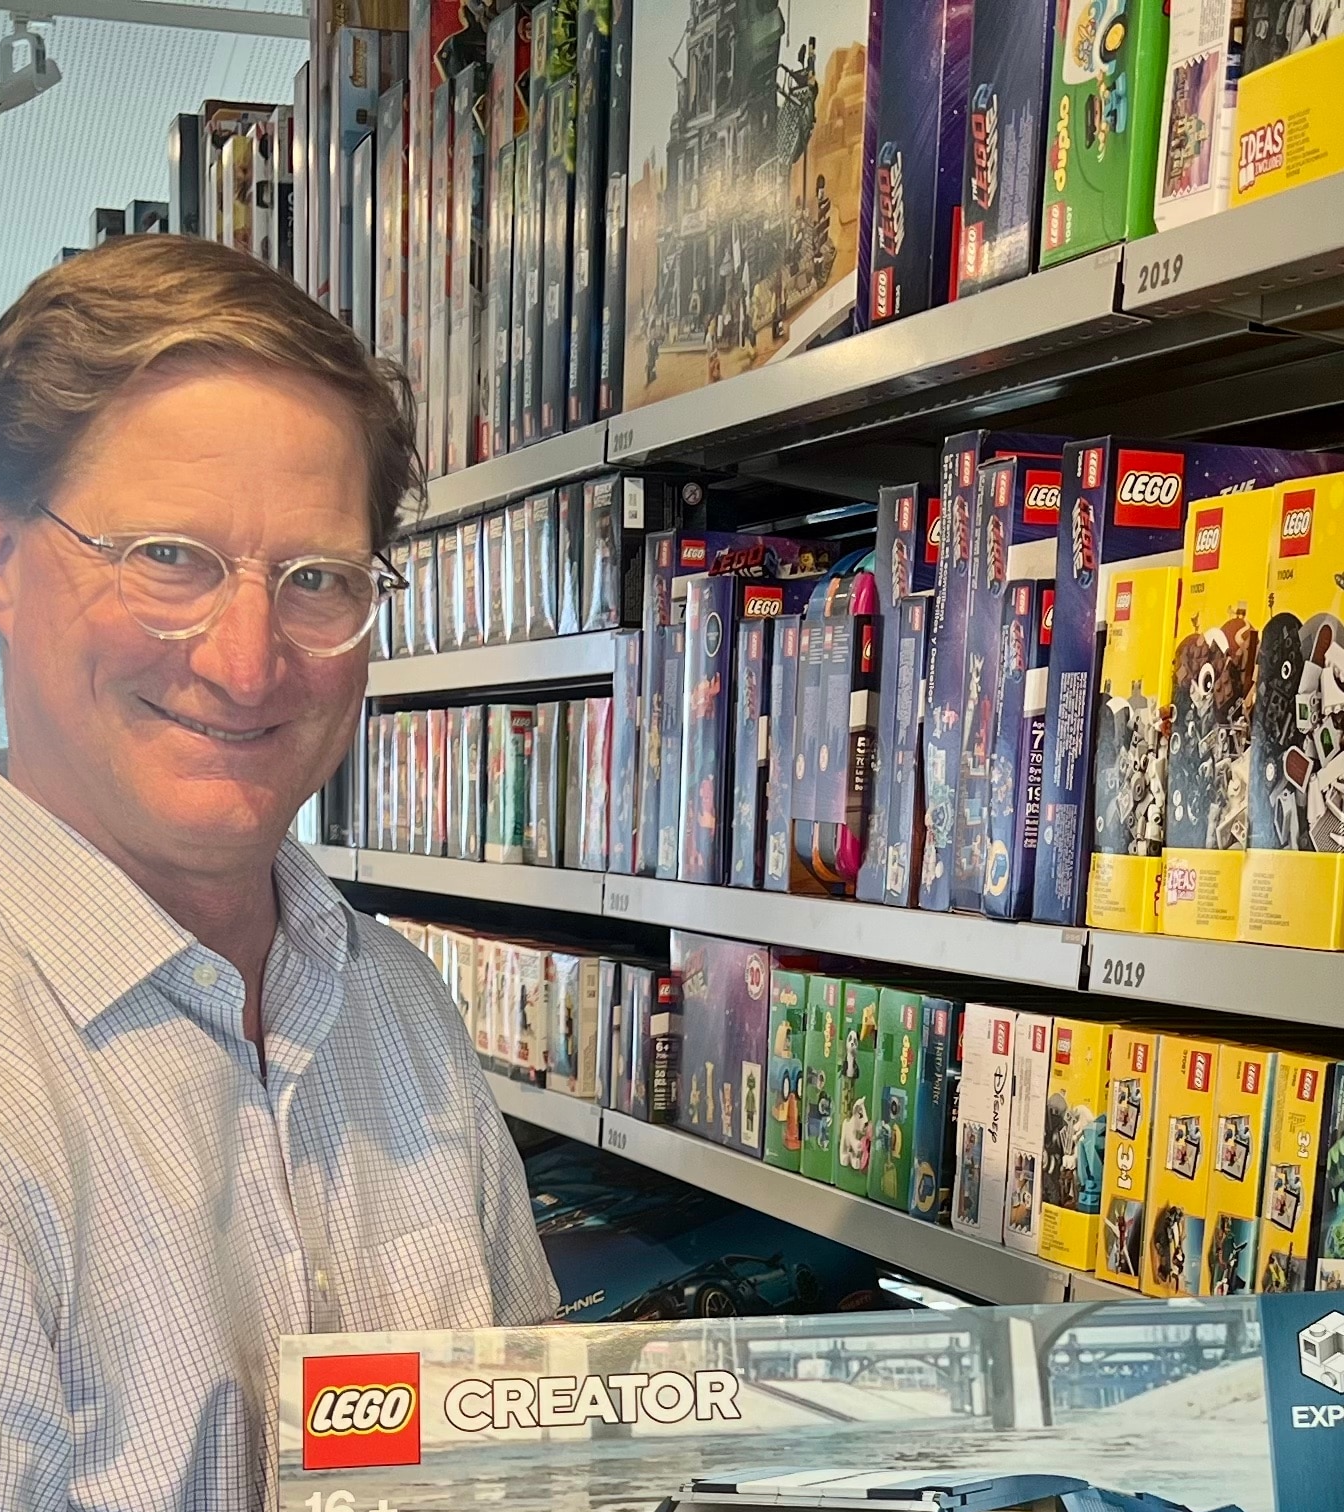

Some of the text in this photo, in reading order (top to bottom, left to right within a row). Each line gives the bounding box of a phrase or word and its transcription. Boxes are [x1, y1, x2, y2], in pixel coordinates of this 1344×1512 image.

[1054, 96, 1069, 191] duplo
[1238, 121, 1284, 164] IDEAS
[1138, 256, 1184, 293] 2019
[877, 271, 888, 315] LEGO
[1119, 473, 1178, 506] LEGO
[1282, 508, 1312, 539] LEGO
[684, 549, 704, 559] LEGO
[1196, 524, 1219, 555] LEGO
[709, 543, 765, 573] LEGO
[1277, 569, 1294, 581] 11004
[747, 598, 780, 615] LEGO
[1103, 958, 1145, 987] 2019
[824, 1012, 833, 1057] duplo
[996, 1023, 1009, 1054] LEGO
[900, 1035, 911, 1085] duplo
[1194, 1056, 1208, 1088] LEGO
[1245, 1065, 1256, 1092] LEGO
[1302, 1071, 1315, 1098] LEGO
[993, 1062, 1009, 1144] Disney
[608, 1128, 628, 1150] 2019
[309, 1387, 413, 1434] LEGO
[444, 1371, 742, 1432] CREATOR
